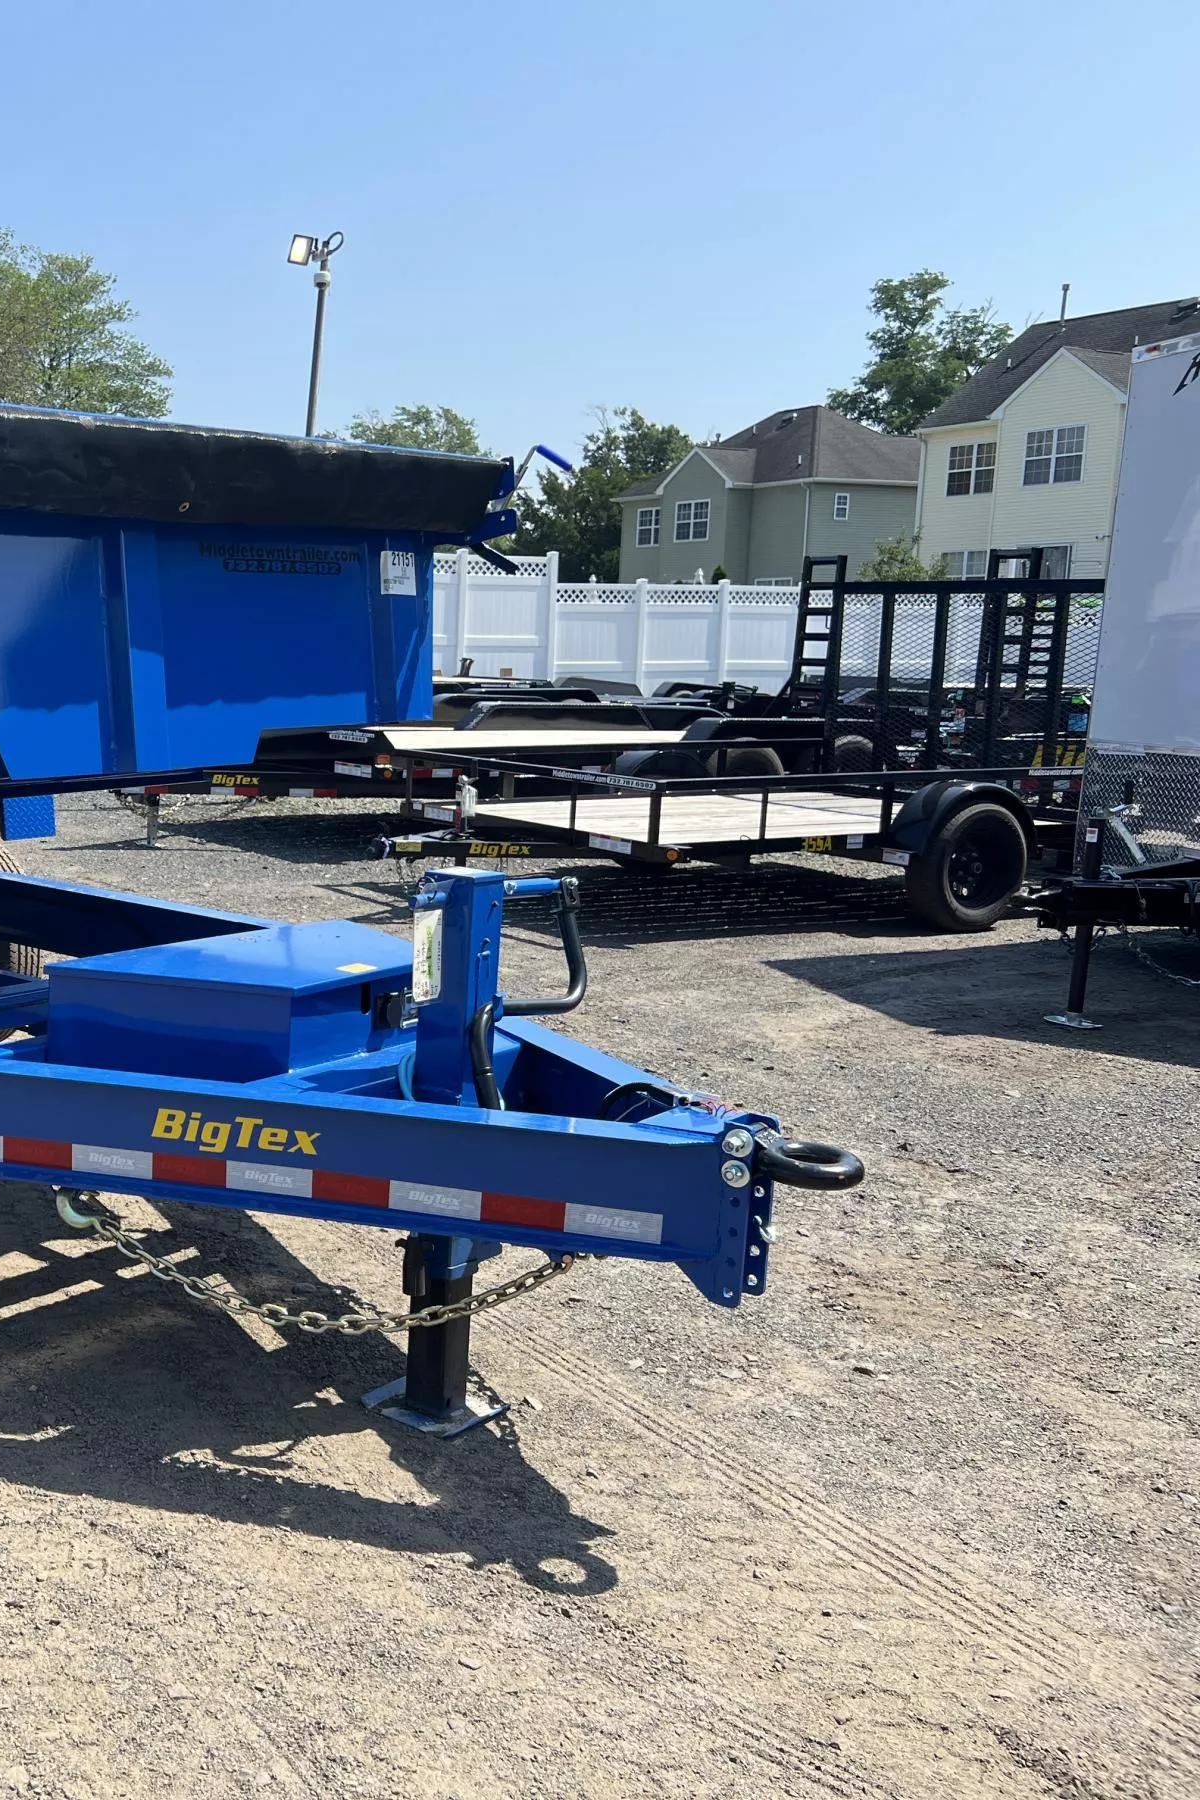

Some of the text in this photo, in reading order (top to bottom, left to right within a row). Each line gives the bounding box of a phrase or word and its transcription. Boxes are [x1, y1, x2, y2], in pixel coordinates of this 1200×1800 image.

[199, 542, 360, 562] Middletowntrailer.com
[391, 551, 414, 567] 21151
[211, 774, 260, 787] BigTex
[468, 842, 531, 857] BigTex
[151, 1107, 322, 1156] BigTex
[88, 1152, 136, 1166] BigTex
[244, 1169, 294, 1184] BigTex
[408, 1190, 460, 1205] BigTex
[584, 1213, 641, 1228] BigTex
